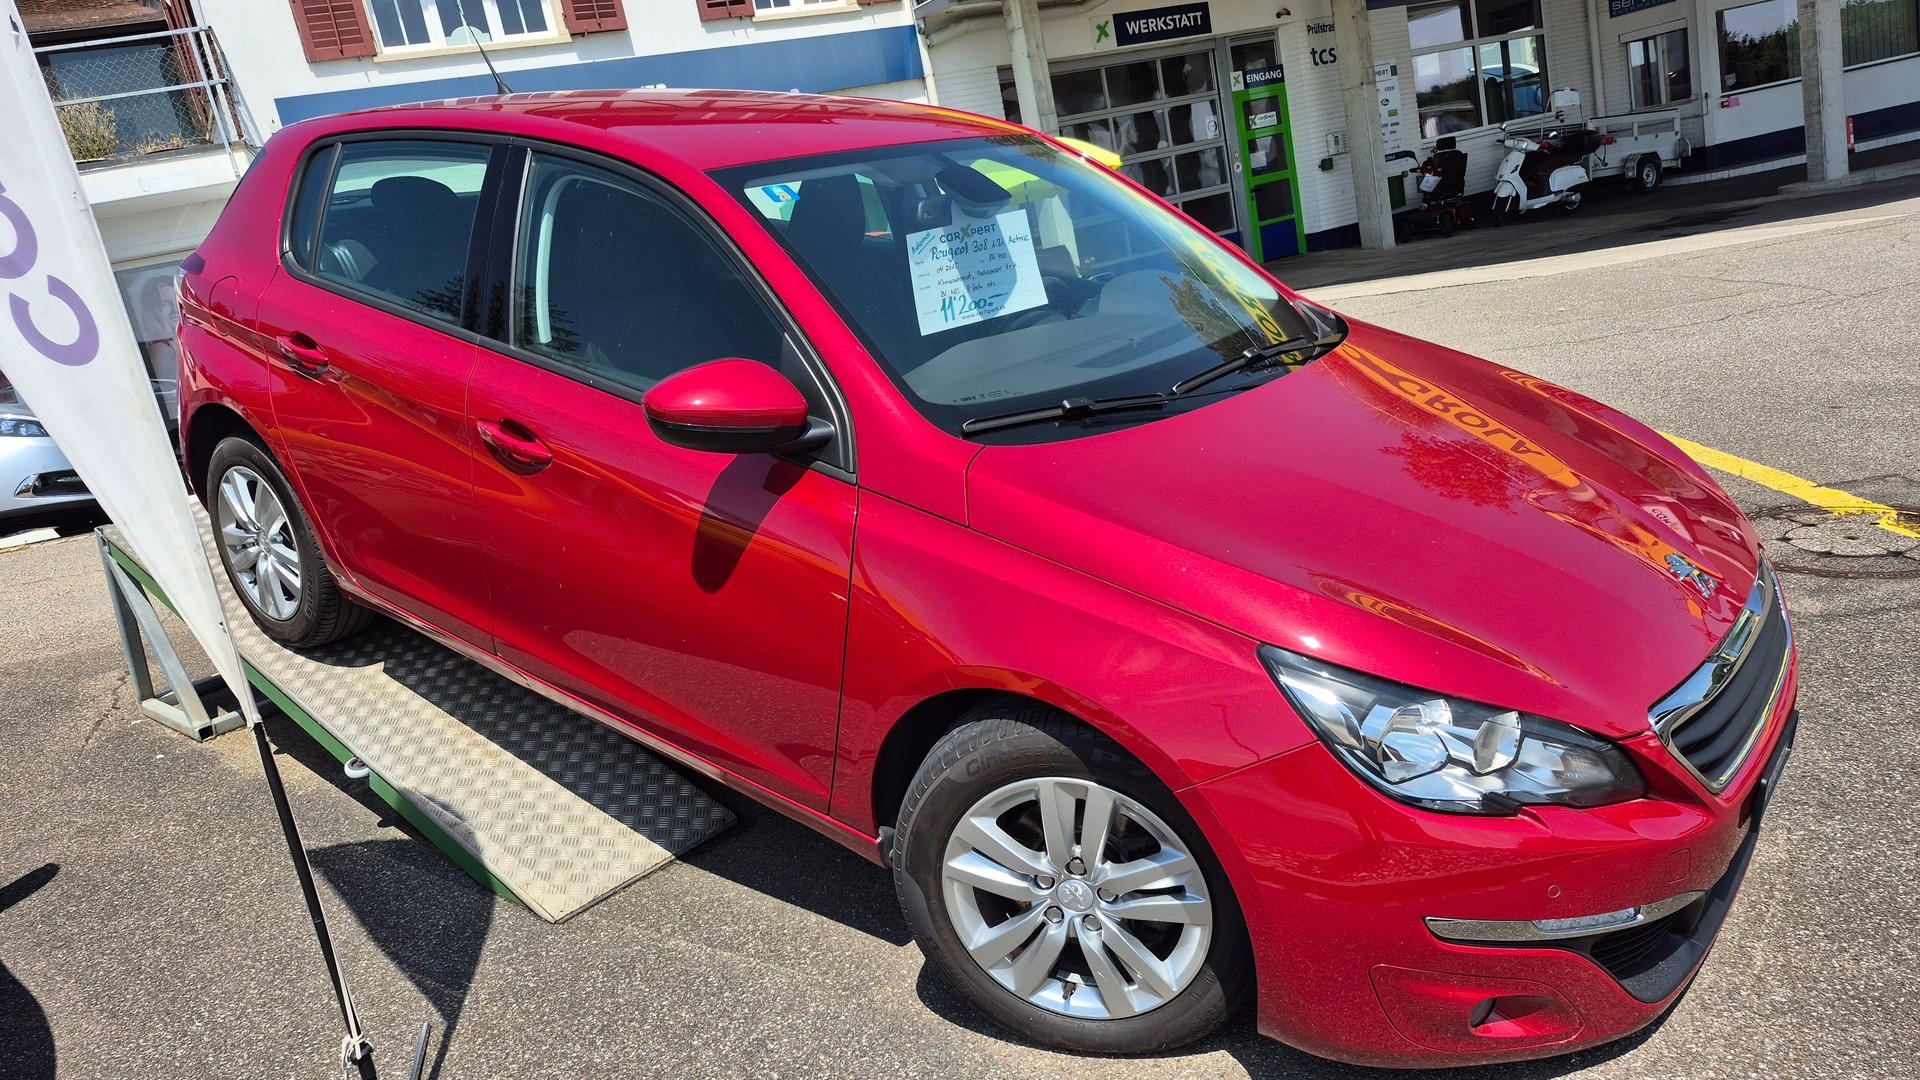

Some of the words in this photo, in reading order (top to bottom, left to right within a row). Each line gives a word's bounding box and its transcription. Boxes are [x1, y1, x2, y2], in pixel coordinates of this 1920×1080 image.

[1126, 12, 1202, 35] WERKSTATT
[1310, 47, 1337, 66] tcs
[1246, 69, 1282, 83] EINGANG
[929, 244, 969, 263] Peugeot
[971, 240, 988, 253] 308
[1008, 234, 1030, 244] Active
